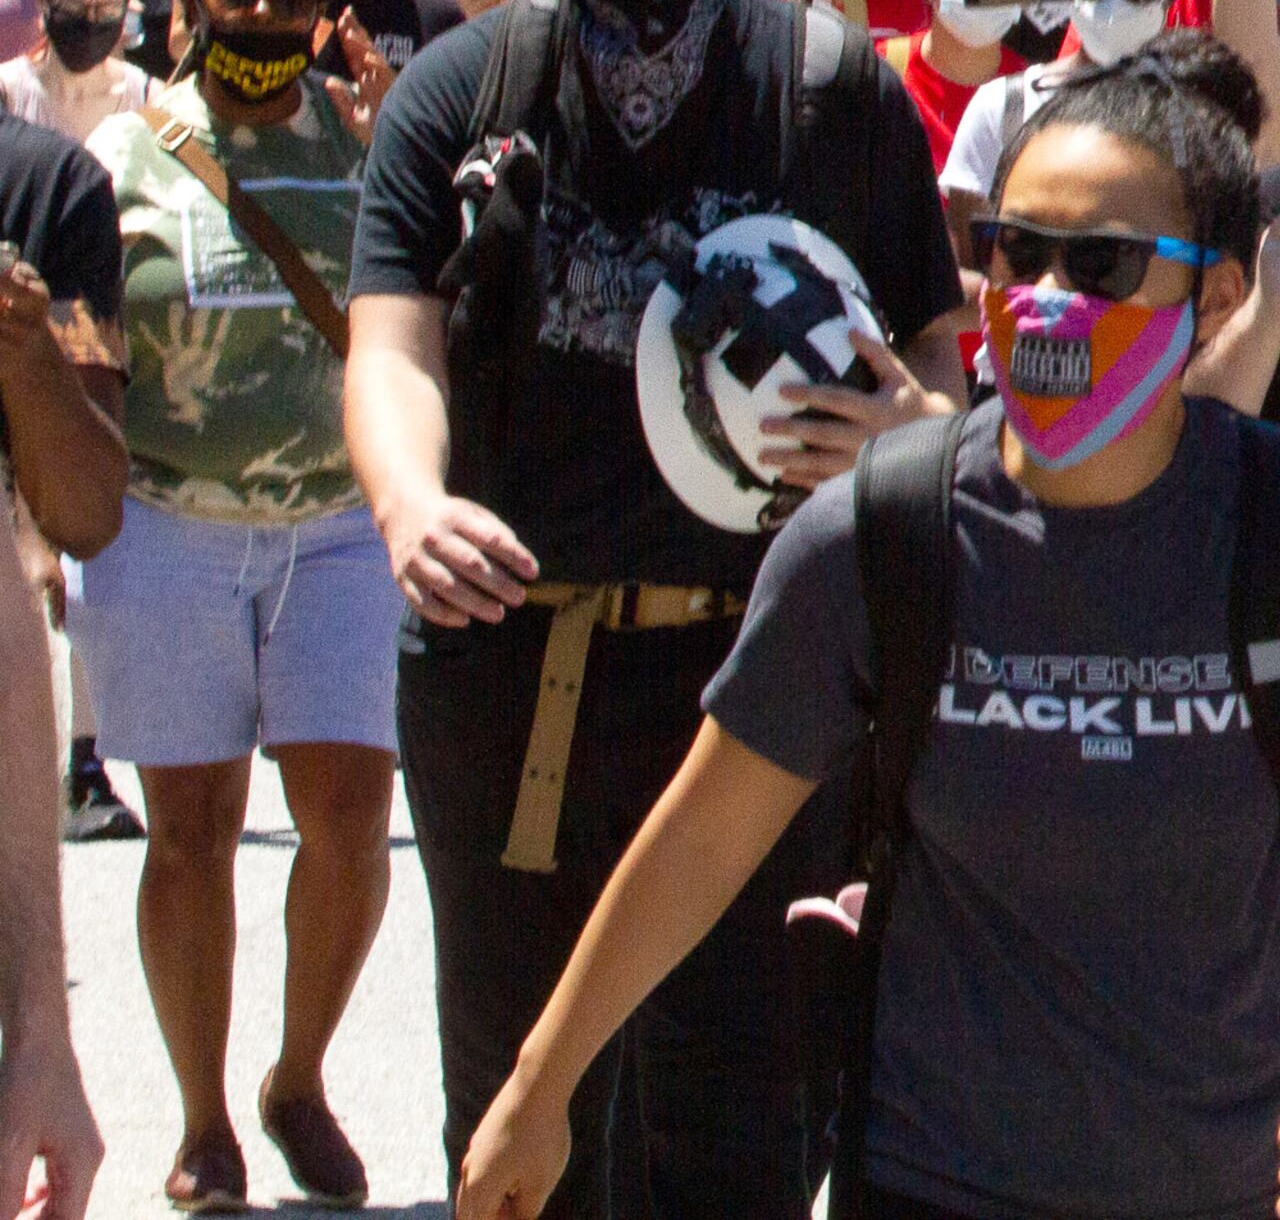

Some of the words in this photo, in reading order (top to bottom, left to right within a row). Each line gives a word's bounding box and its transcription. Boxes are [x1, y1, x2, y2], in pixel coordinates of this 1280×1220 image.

[963, 647, 1232, 693] DEFENSE
[935, 683, 1123, 736] LACK
[1135, 691, 1252, 737] LIV
